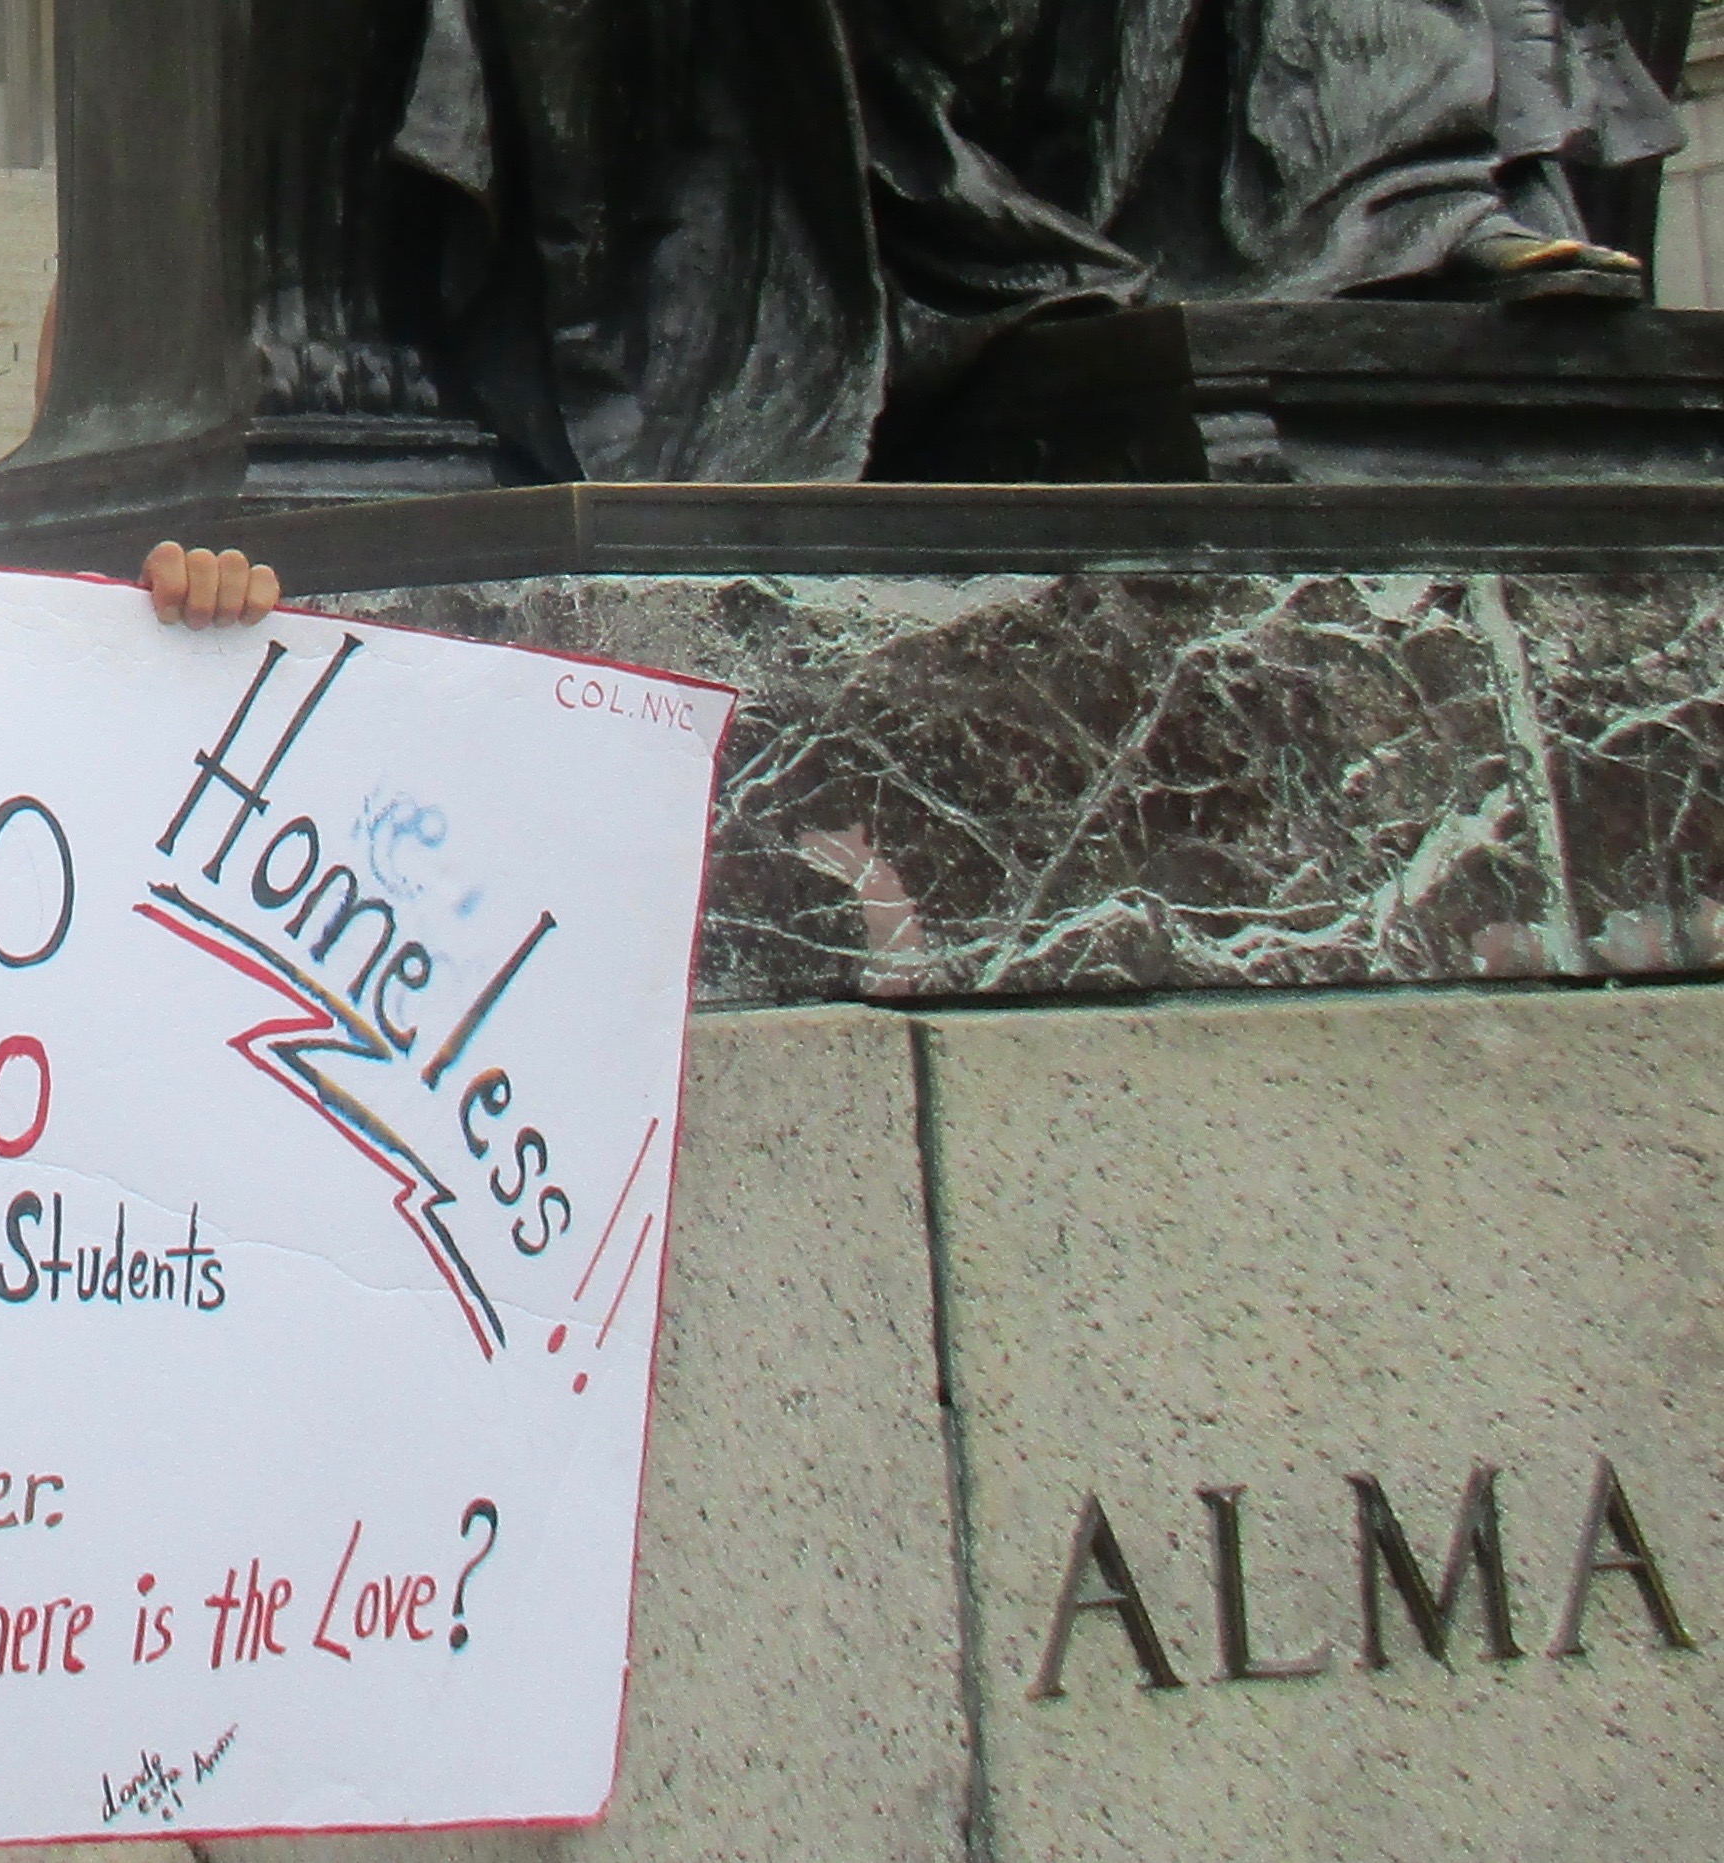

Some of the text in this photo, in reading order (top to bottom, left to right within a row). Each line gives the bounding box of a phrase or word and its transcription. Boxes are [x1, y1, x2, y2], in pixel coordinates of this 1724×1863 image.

[133, 1573, 174, 1664] is
[204, 1557, 293, 1670] the
[312, 1497, 498, 1661] Love?
[1026, 1451, 1702, 1702] ALMA
